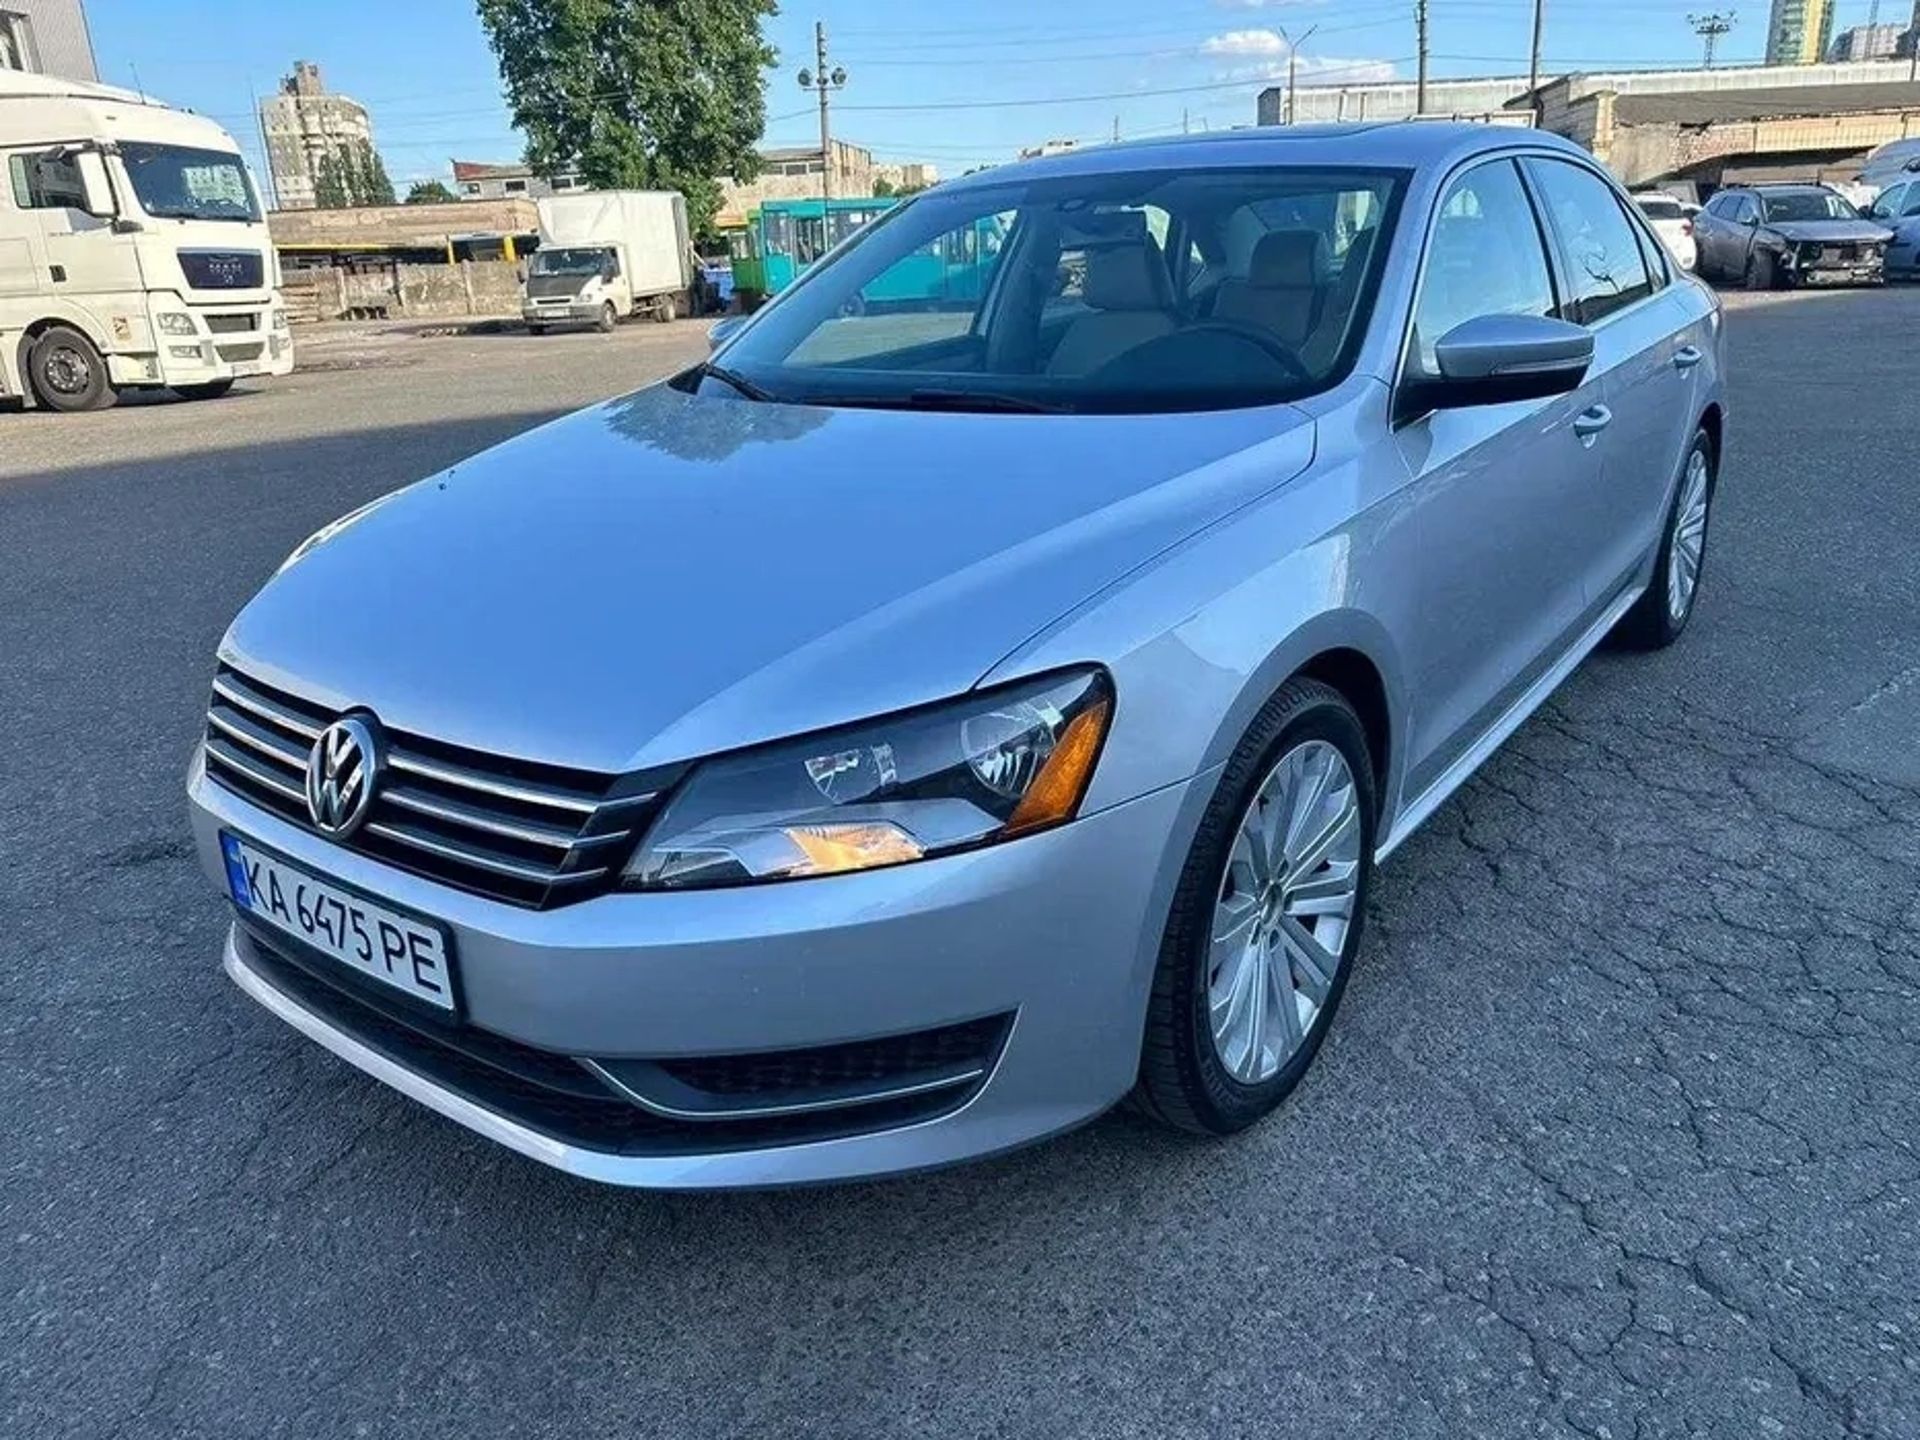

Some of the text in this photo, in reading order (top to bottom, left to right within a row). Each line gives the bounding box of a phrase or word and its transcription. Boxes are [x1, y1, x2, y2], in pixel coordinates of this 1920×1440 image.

[242, 854, 442, 994] KA 6475 PE
